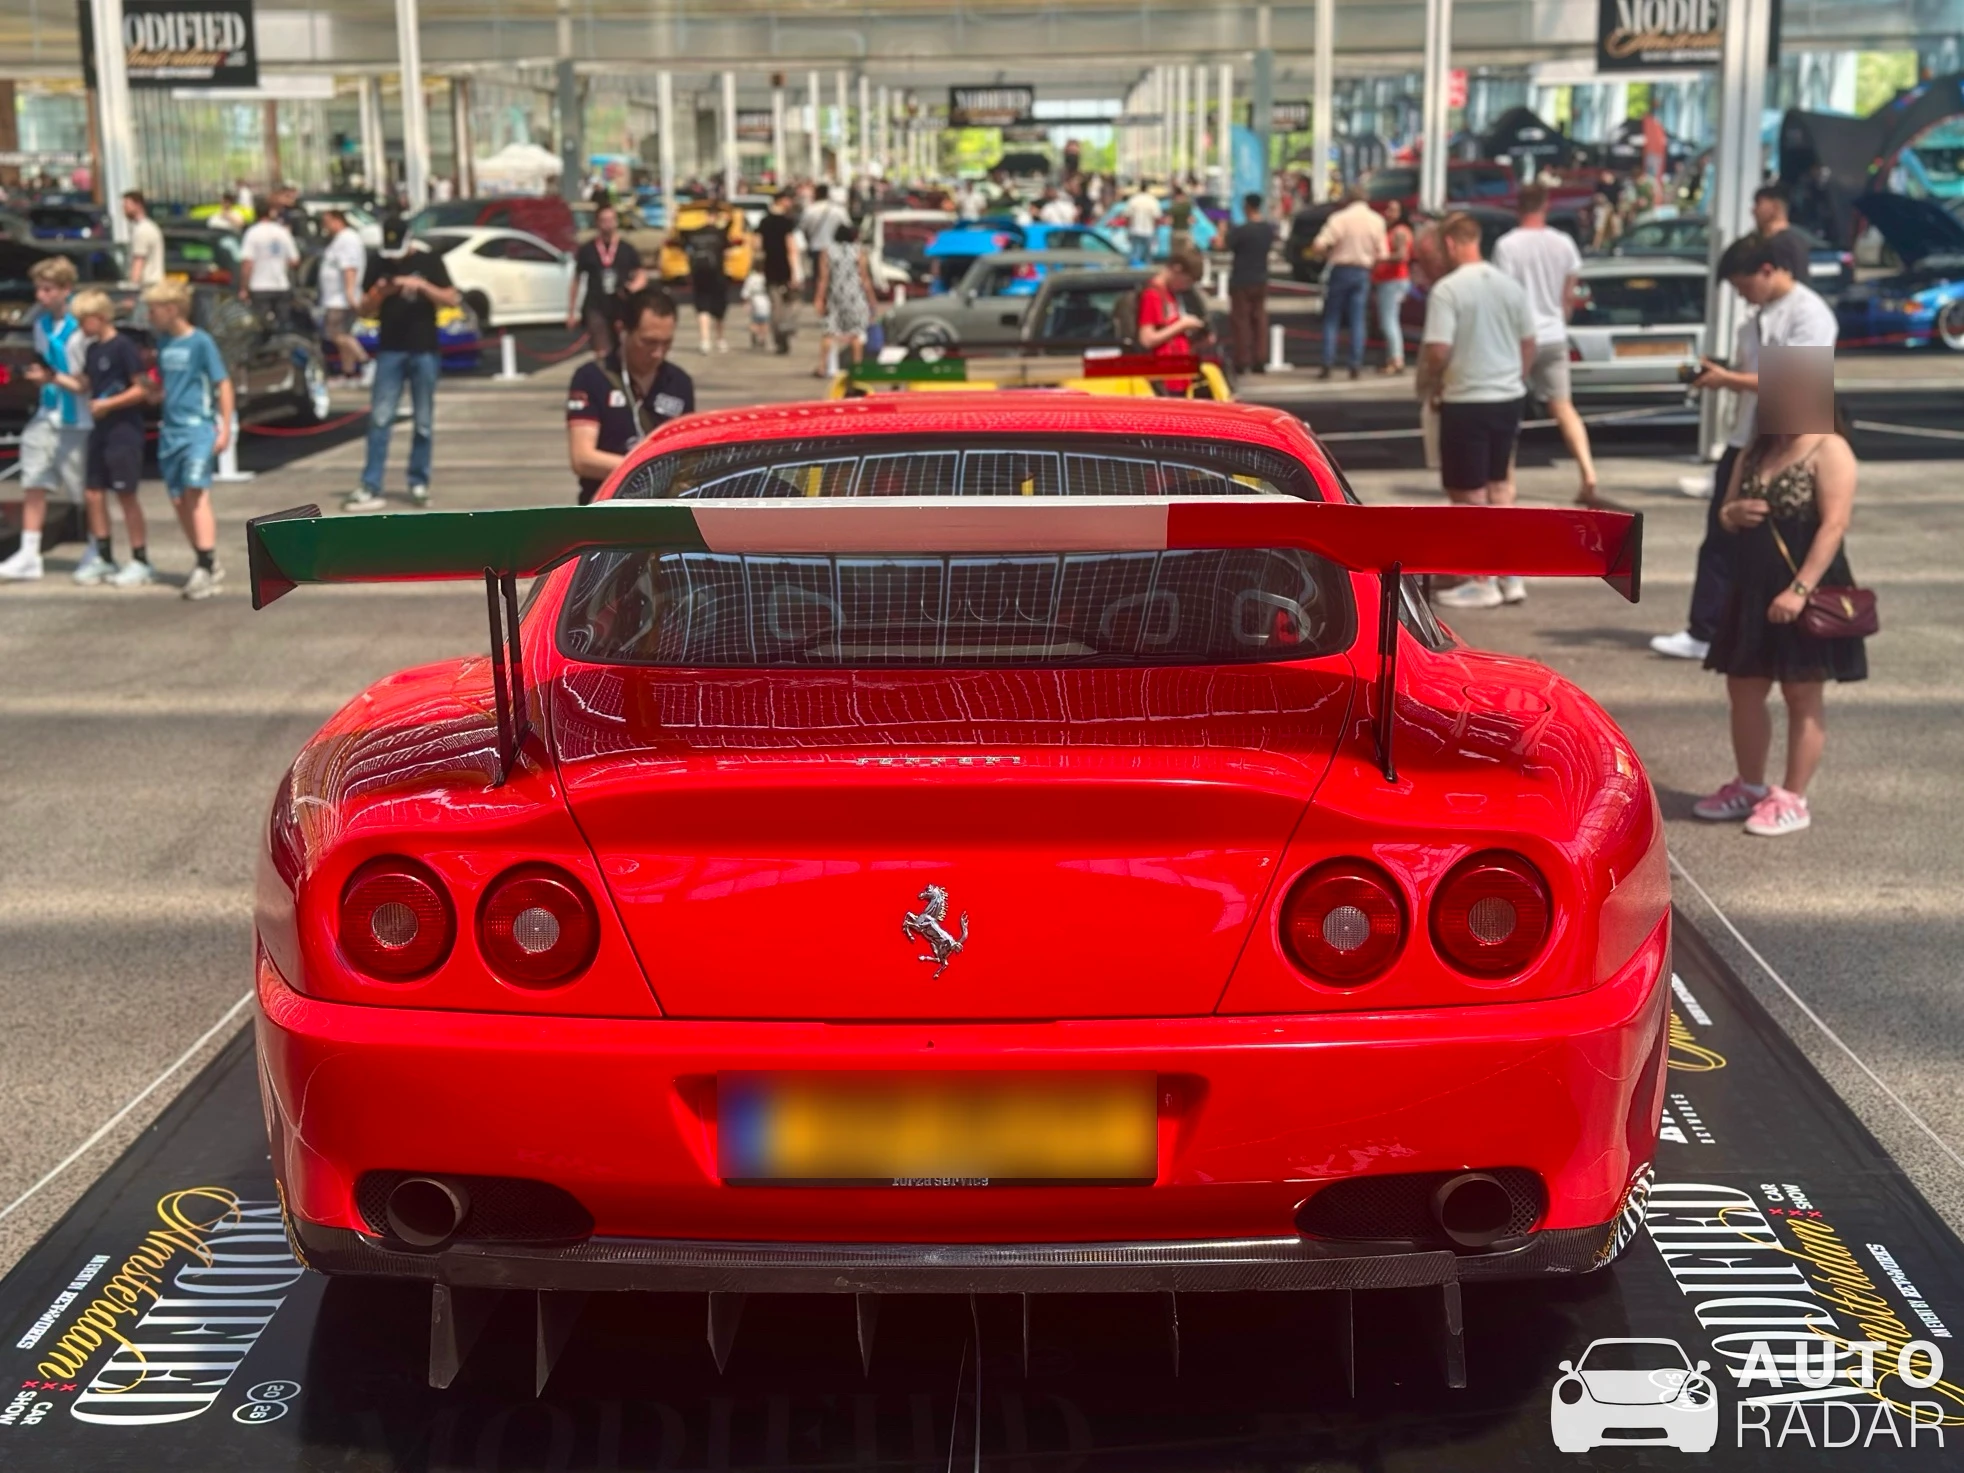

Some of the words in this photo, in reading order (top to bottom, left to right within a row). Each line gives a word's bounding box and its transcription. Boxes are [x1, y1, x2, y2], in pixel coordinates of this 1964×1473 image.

[124, 11, 246, 51] ODIFIED
[1760, 1183, 1784, 1202] CAR
[1782, 1183, 1813, 1210] SHOW
[38, 1186, 242, 1393] Amsterdam
[263, 1384, 285, 1399] 20
[0, 1390, 38, 1426] SHOW
[20, 1401, 54, 1426] CAR
[249, 1404, 271, 1419] 26
